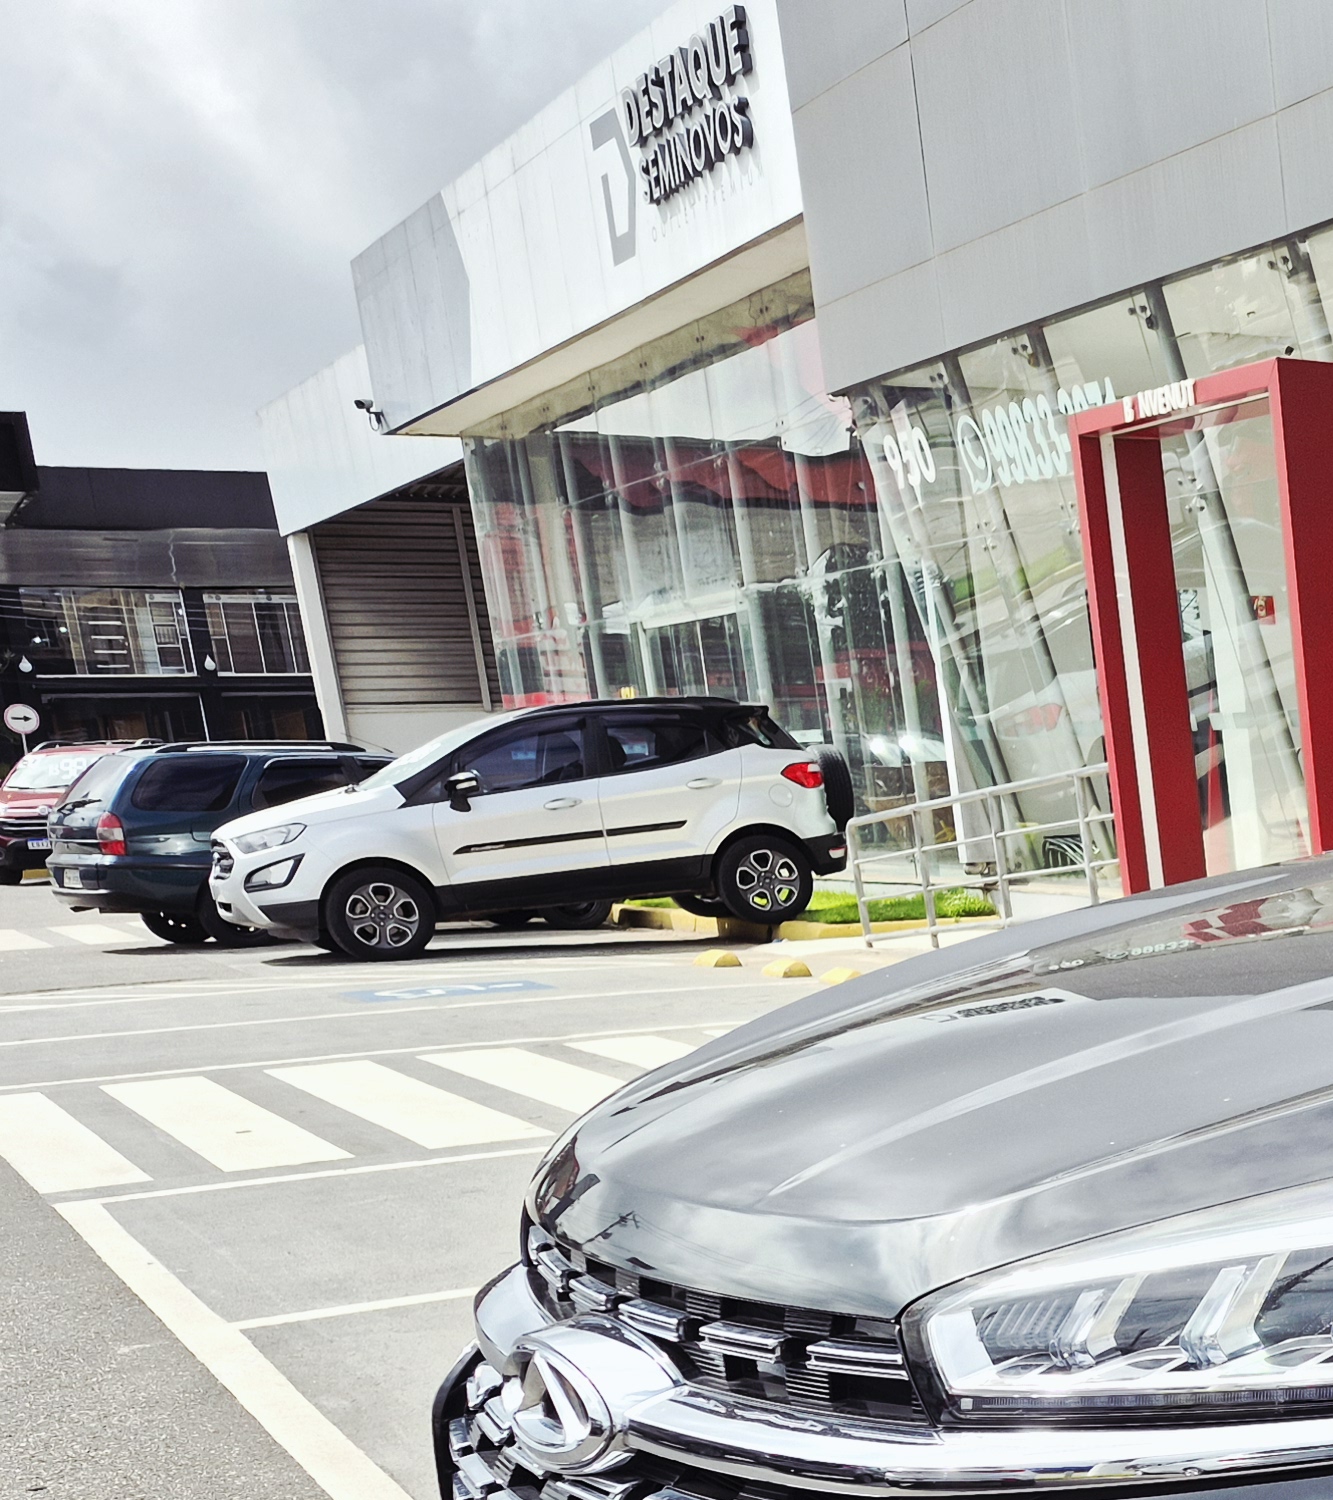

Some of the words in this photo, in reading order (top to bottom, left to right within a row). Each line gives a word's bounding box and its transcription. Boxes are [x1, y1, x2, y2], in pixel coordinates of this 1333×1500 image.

[621, 4, 753, 148] DESTAQUE
[639, 95, 753, 205] SEMINOVOS
[883, 427, 936, 490] 950
